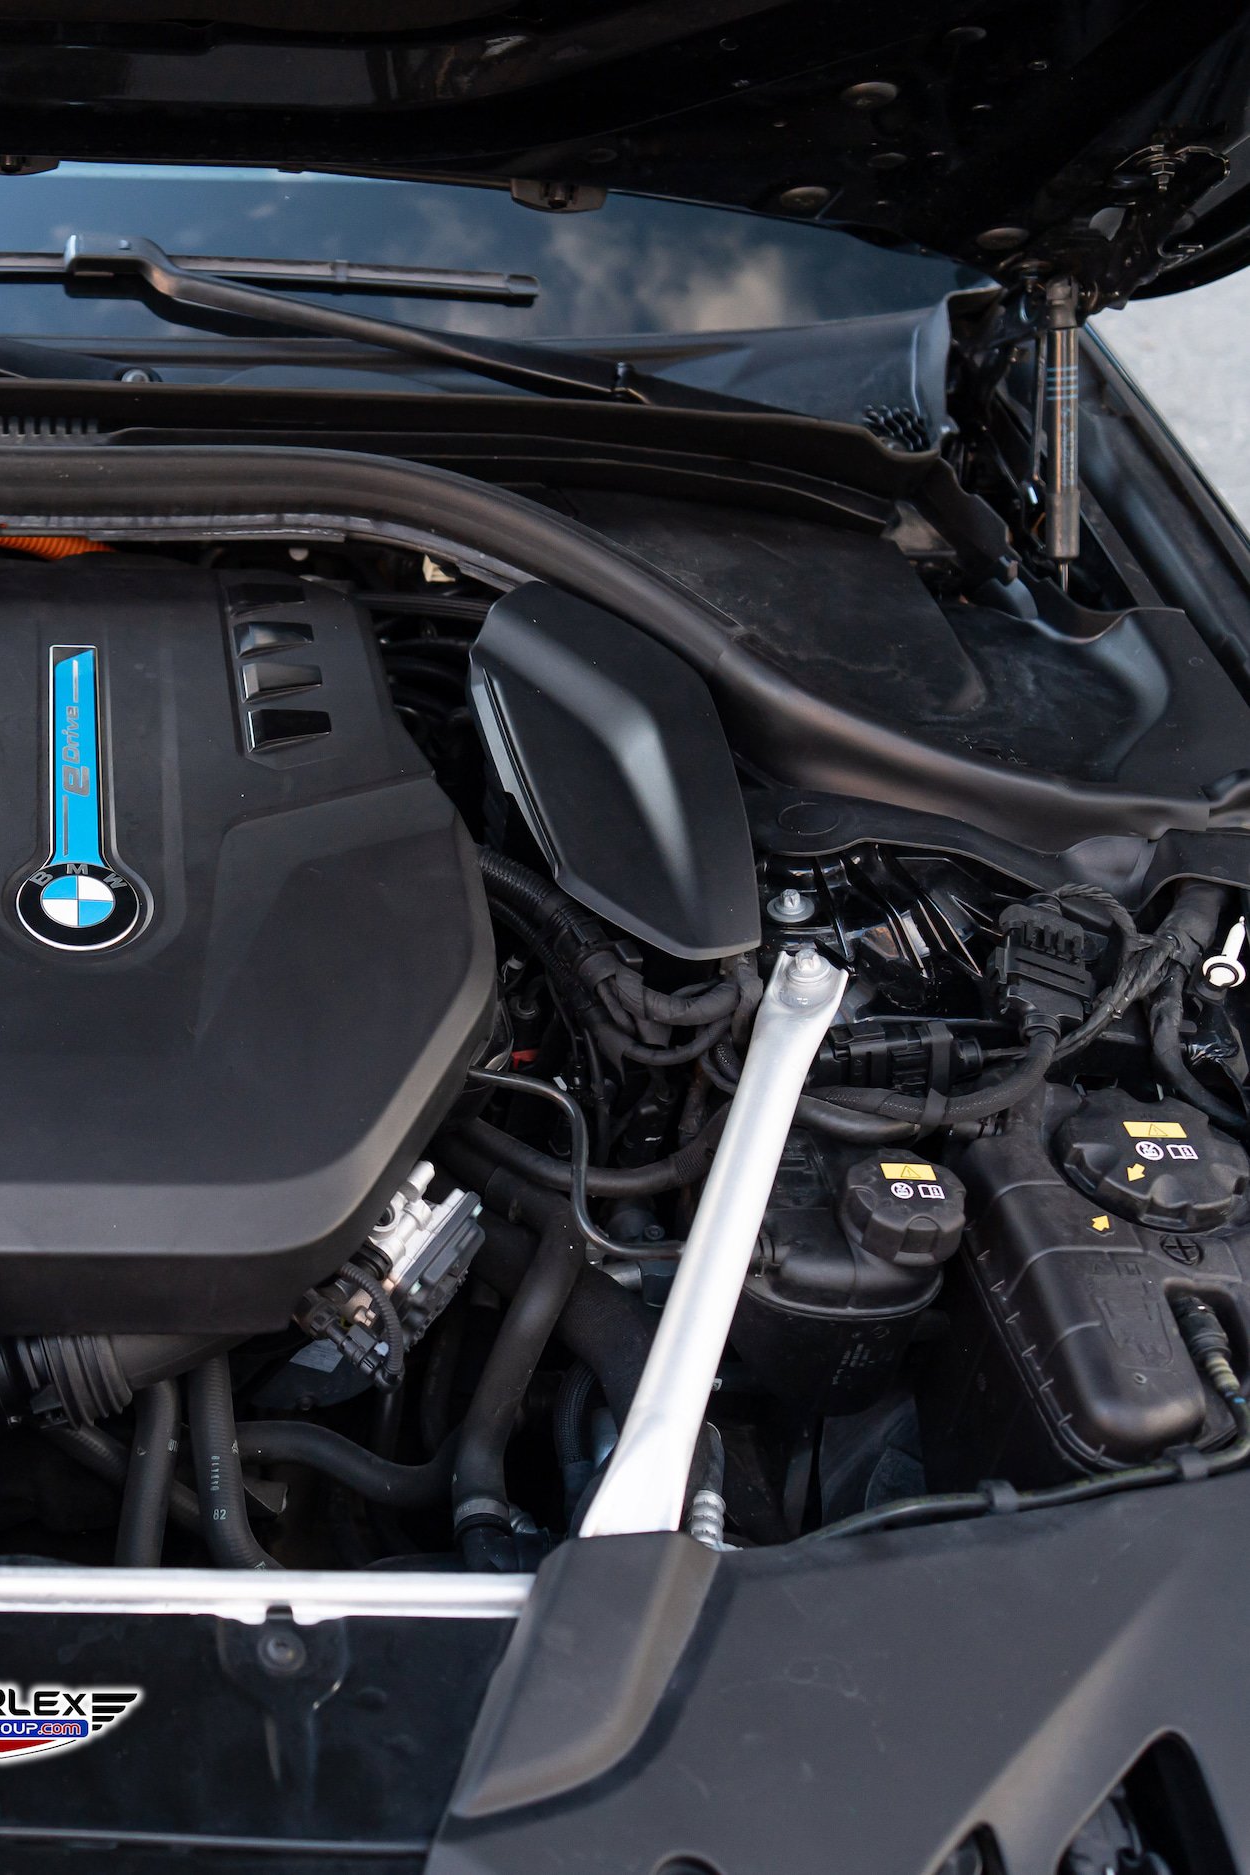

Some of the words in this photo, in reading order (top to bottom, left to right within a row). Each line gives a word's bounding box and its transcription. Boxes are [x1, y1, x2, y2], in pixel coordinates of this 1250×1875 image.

[61, 705, 90, 797] eDrive
[30, 863, 128, 890] BMW
[212, 1508, 227, 1521] 82
